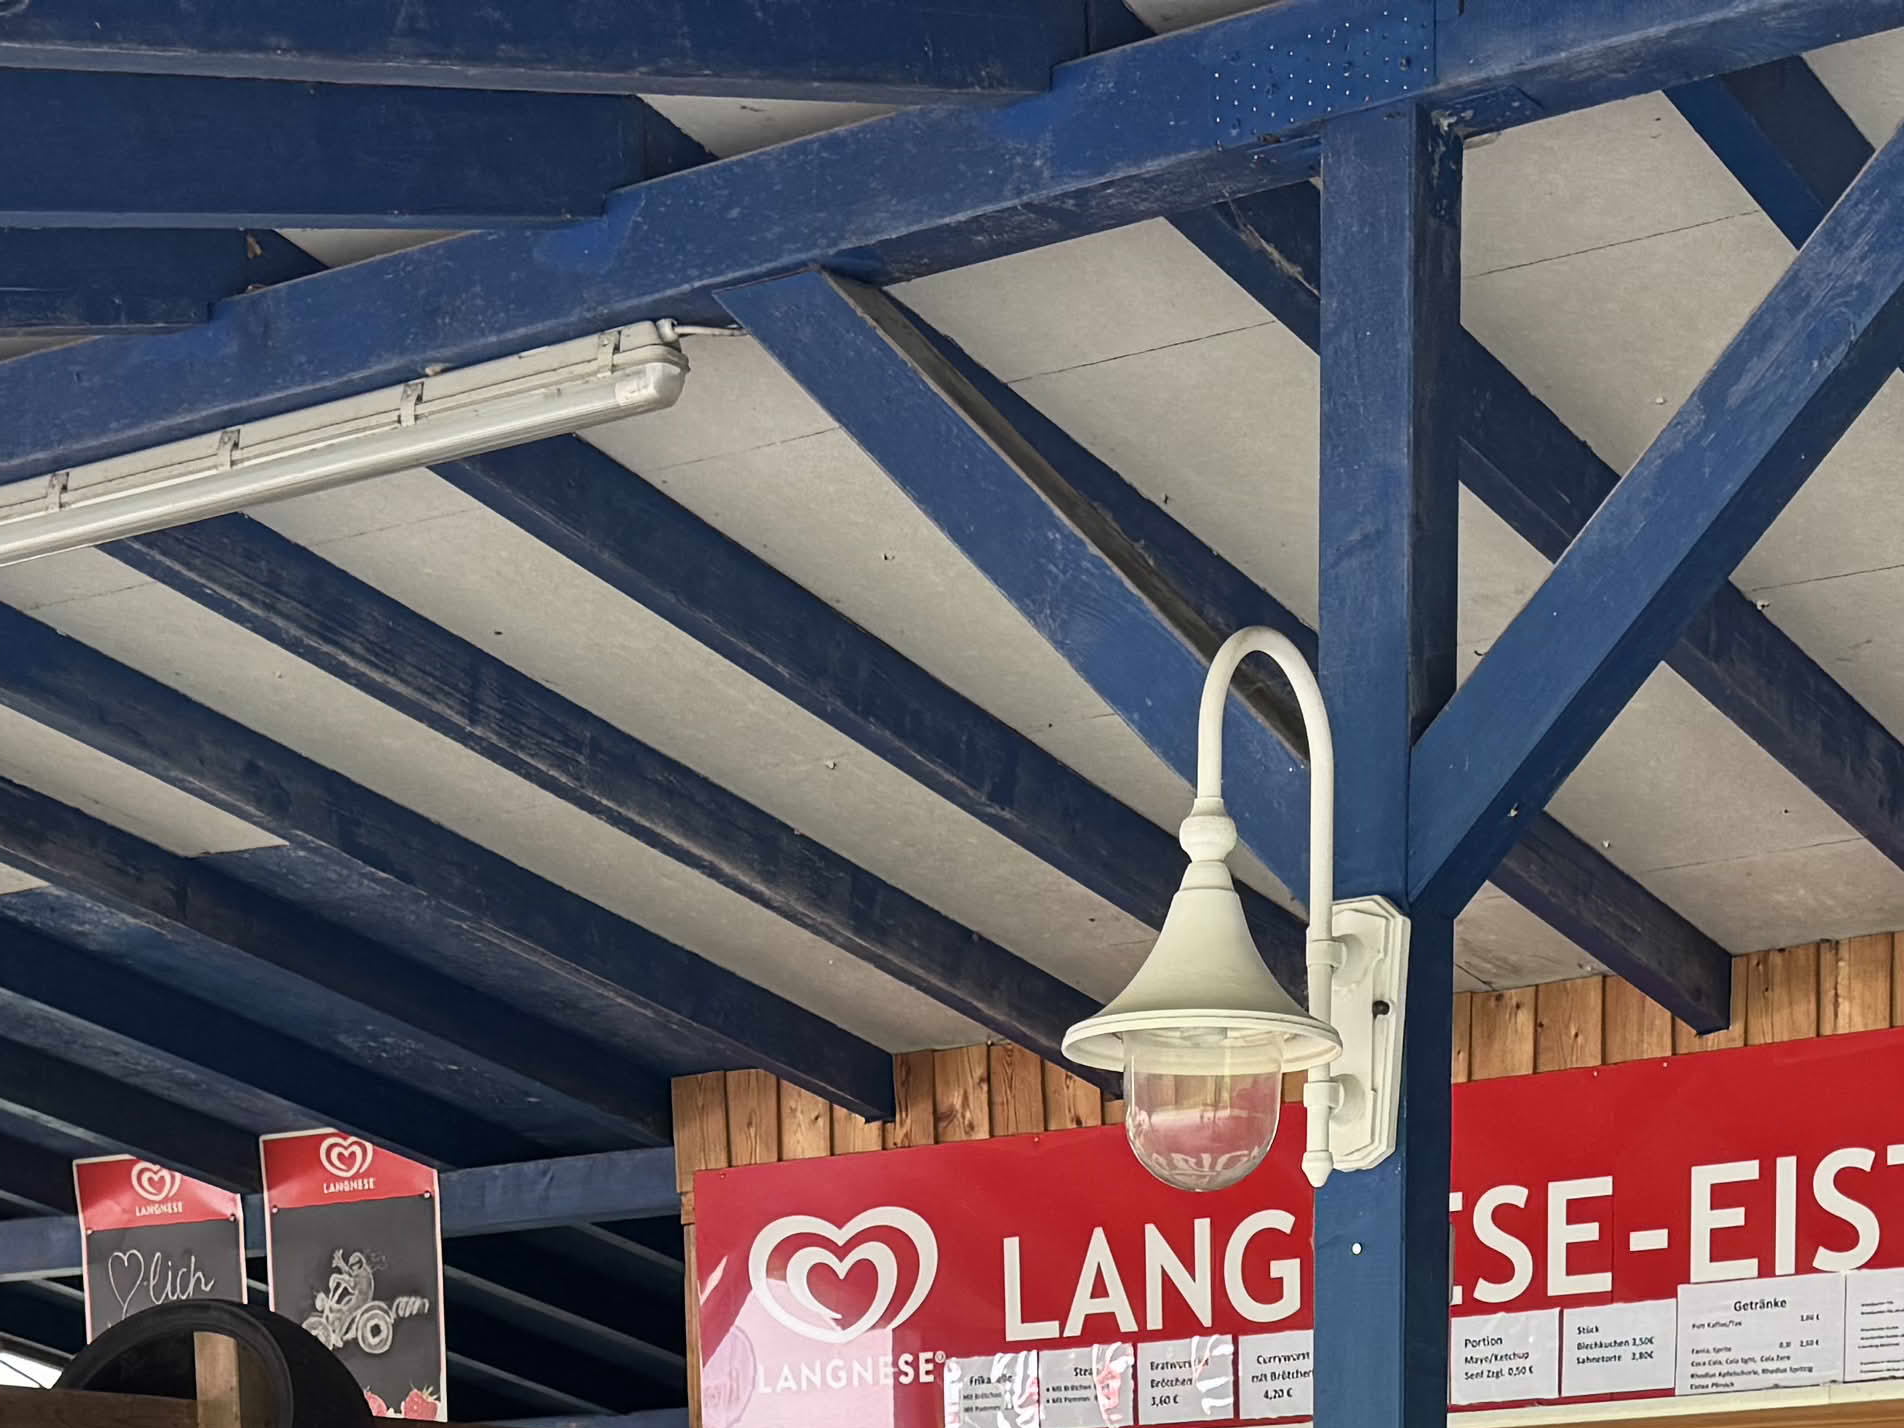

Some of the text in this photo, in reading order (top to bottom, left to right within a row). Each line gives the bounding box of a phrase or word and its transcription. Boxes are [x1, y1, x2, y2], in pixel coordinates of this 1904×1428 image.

[323, 1177, 375, 1195] LANGNESE
[1733, 1298, 1787, 1312] Getränke
[1464, 1335, 1503, 1348] Portion
[758, 1350, 936, 1393] LANGNESE
